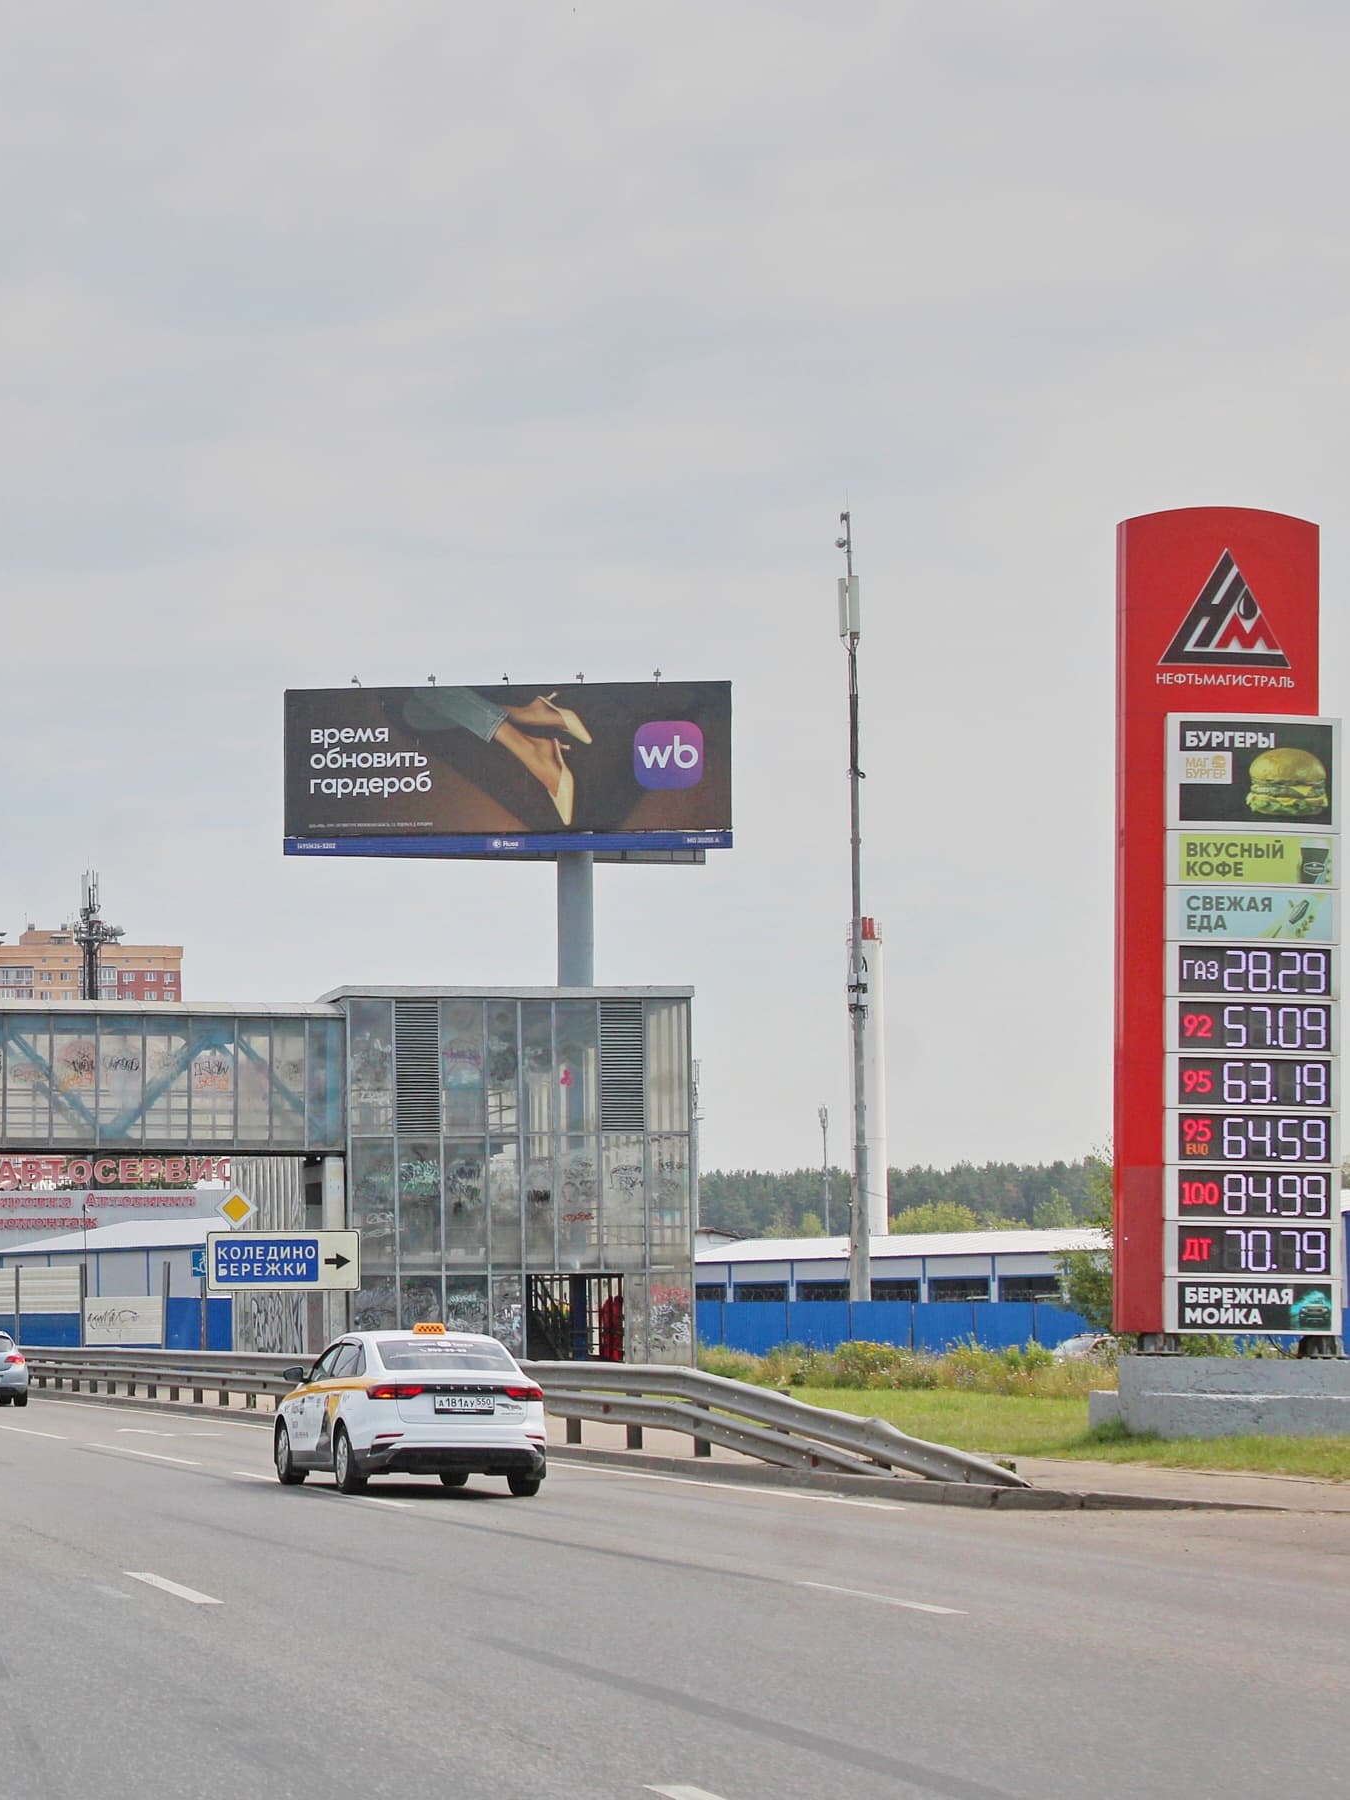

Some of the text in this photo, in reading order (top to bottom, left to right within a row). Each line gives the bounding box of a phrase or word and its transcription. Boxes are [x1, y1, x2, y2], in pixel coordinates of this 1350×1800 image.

[1155, 672, 1295, 690] НЕФТЬМАГИСТРАЛЬ
[310, 727, 389, 749] время
[1185, 730, 1276, 750] БУРГЕРЫ
[310, 747, 428, 770] обновить
[638, 735, 700, 769] wb
[1185, 757, 1209, 769] МАГ
[1185, 768, 1227, 780] БУРГЕР
[310, 771, 433, 799] гардероб
[1185, 839, 1284, 858] ВКУСНЫЙ
[1185, 860, 1244, 878] КОФЕ
[1185, 895, 1273, 912] СВЕЖАЯ
[1185, 913, 1227, 931] ЕДА
[1182, 950, 1326, 993] ГАЗ 28.29
[1183, 1006, 1326, 1049] 92 57.09
[1182, 1062, 1326, 1104] 95 63.19
[1182, 1118, 1326, 1161] 95 64.59
[1182, 1174, 1326, 1217] 100 84.99
[217, 1246, 316, 1262] КОЛЕДИНО
[1182, 1230, 1326, 1273] ДТ 70.79
[217, 1262, 307, 1277] БЕРЕЖКИ
[1184, 1287, 1294, 1306] БЕРЕЖНАЯ
[1184, 1303, 1263, 1326] МОЙКА
[476, 1398, 491, 1406] 550
